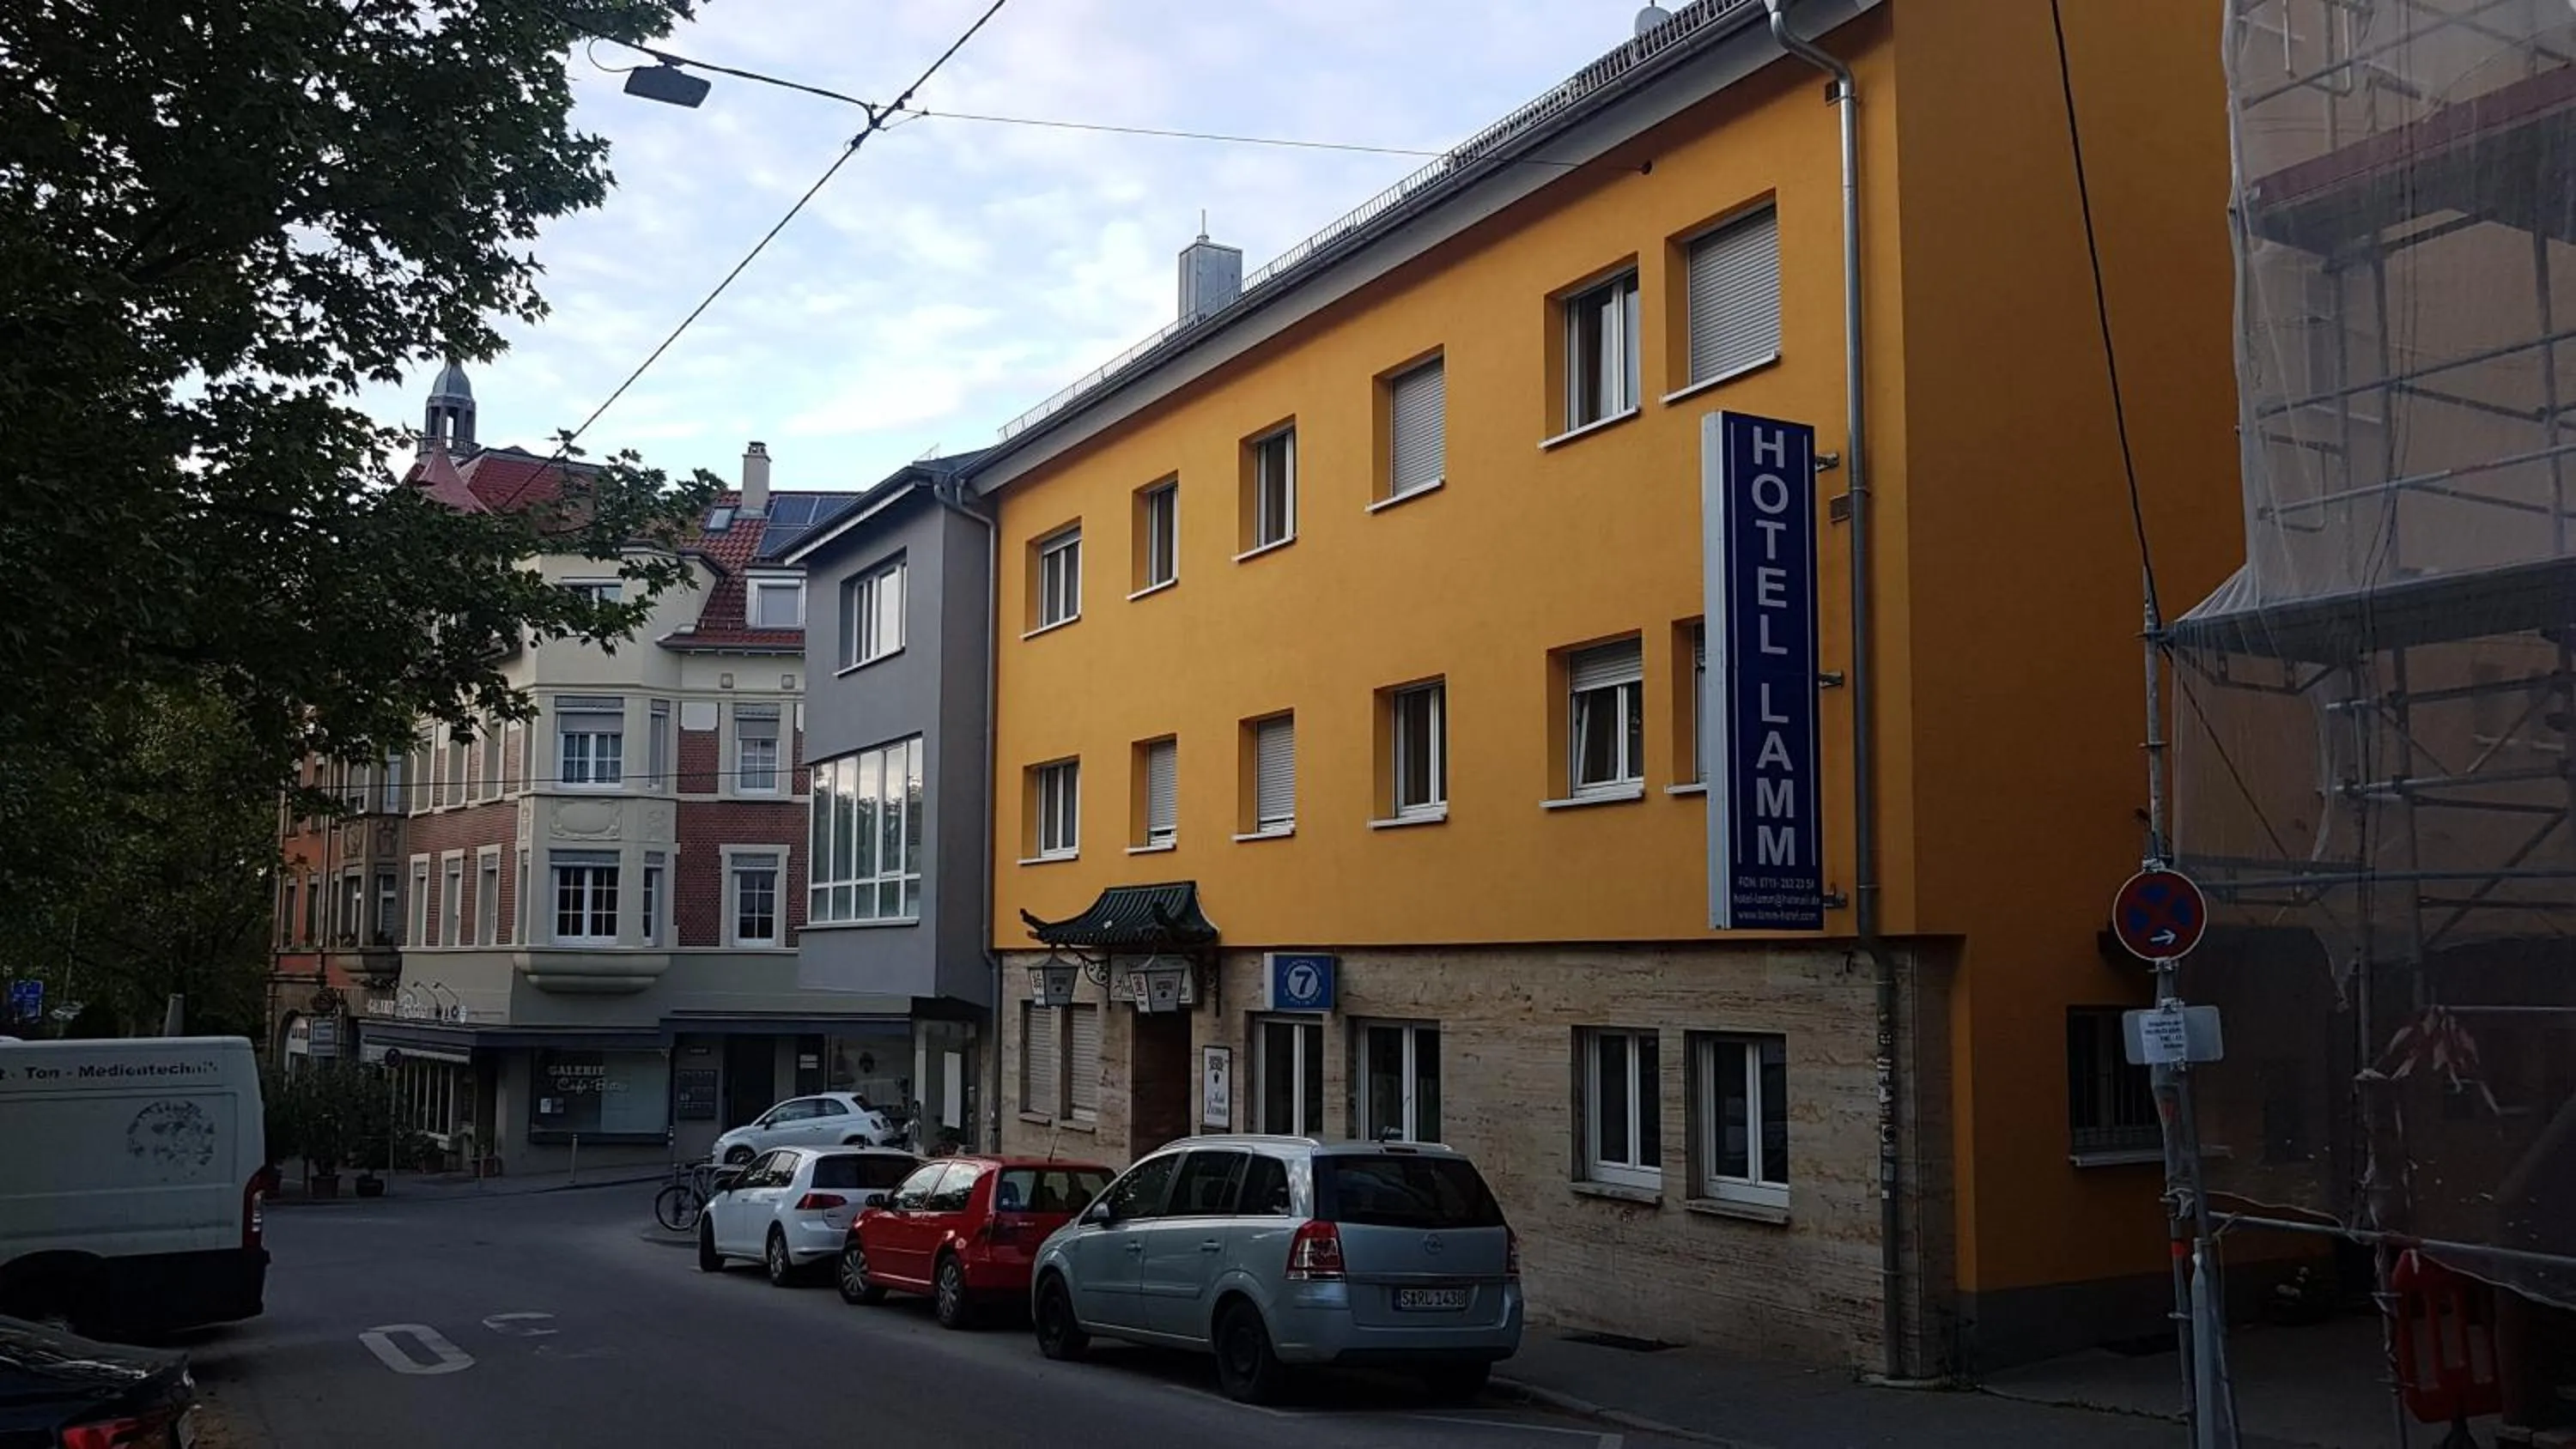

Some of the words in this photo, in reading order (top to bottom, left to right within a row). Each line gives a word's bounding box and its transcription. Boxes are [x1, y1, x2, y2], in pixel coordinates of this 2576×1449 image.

[1751, 425, 1789, 656] HOTEL
[1755, 682, 1795, 867] LAMM
[1294, 970, 1313, 995] 7
